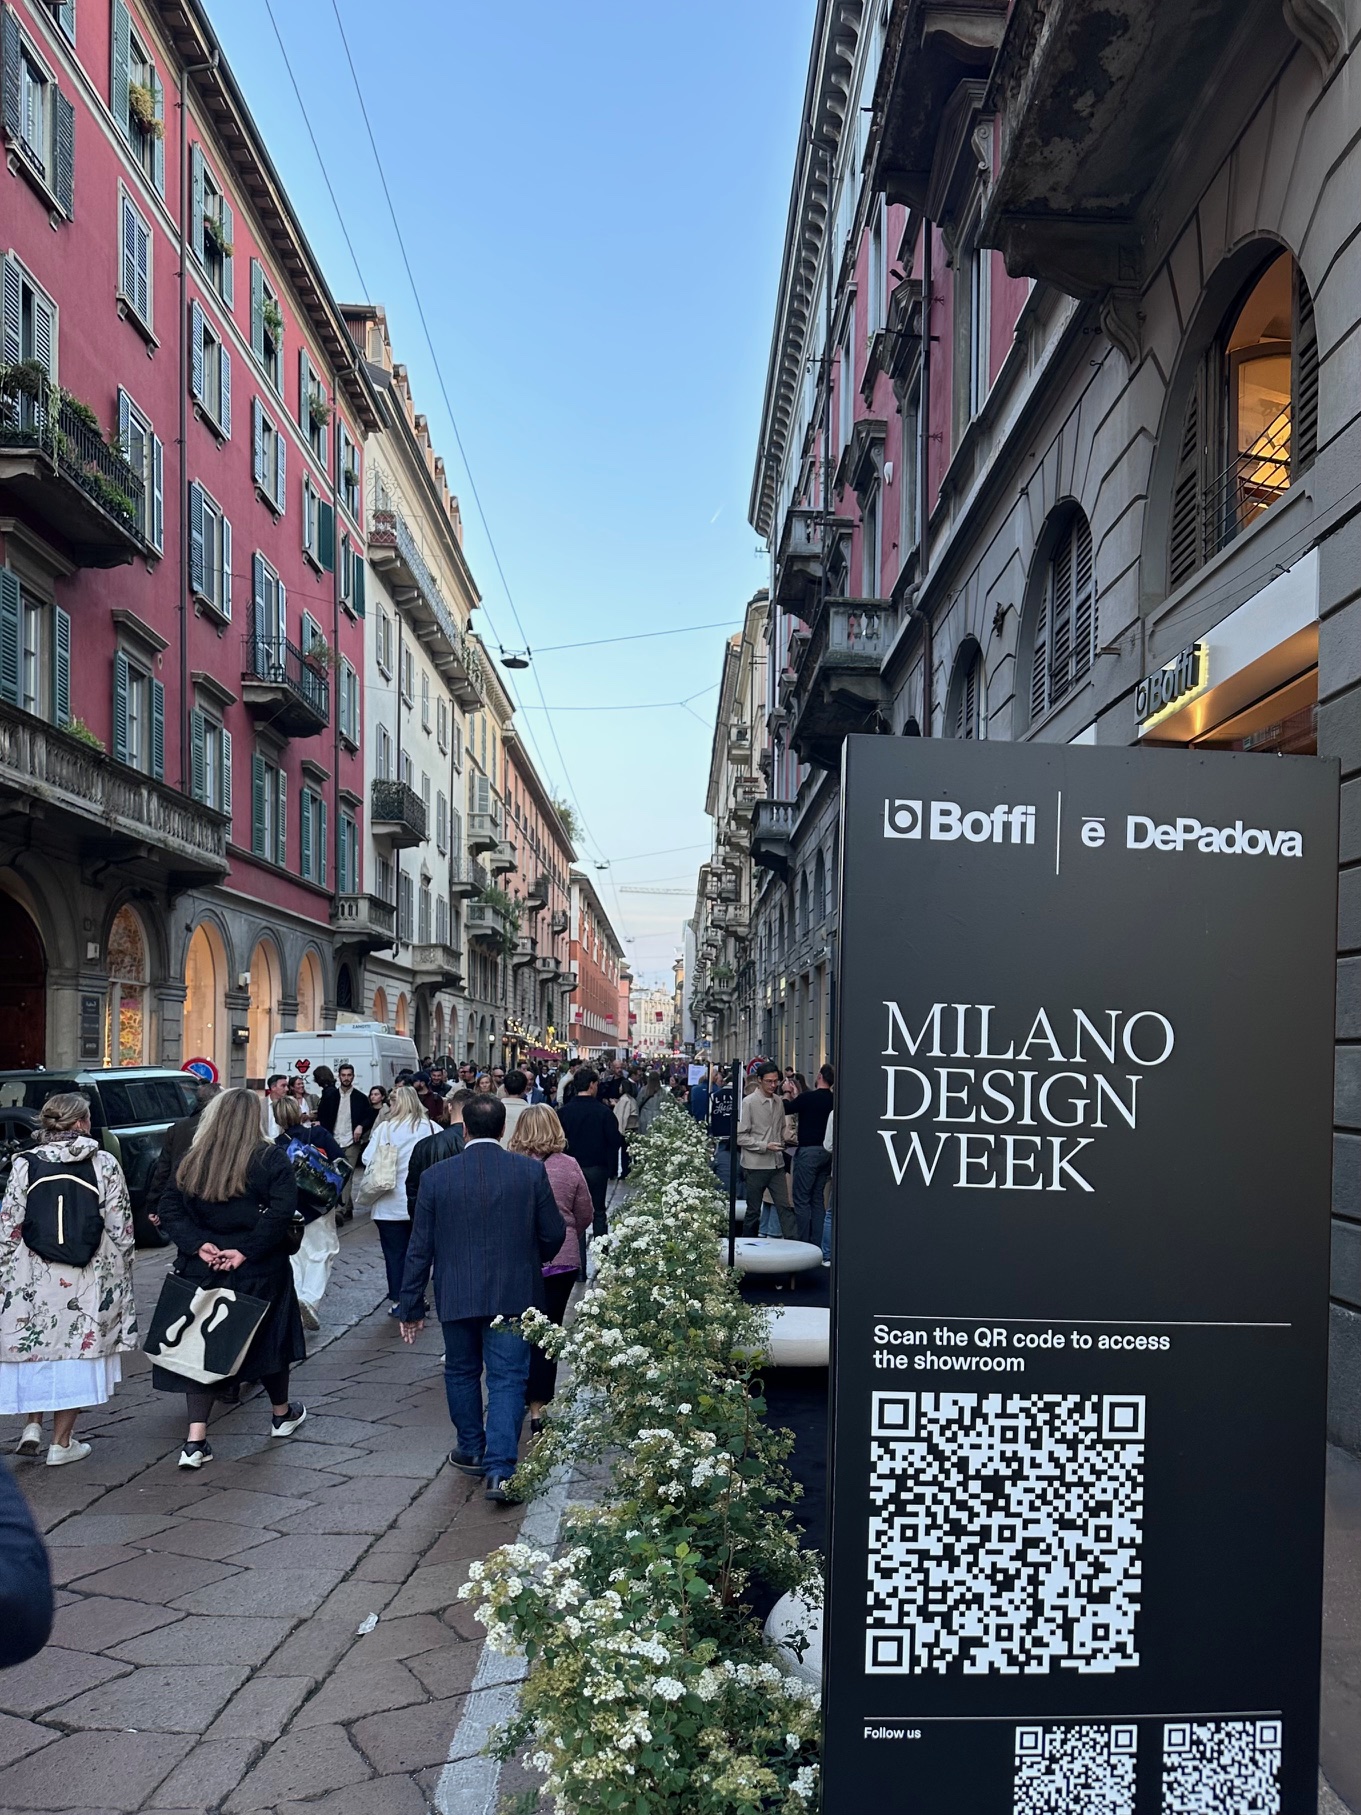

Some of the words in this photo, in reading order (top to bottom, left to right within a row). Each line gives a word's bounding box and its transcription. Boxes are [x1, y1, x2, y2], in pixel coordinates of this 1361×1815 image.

[929, 800, 1036, 845] Boffi
[1126, 814, 1303, 858] DePadova
[881, 1001, 1175, 1066] MILANO
[879, 1065, 1144, 1131] DESIGN
[876, 1130, 1097, 1193] WEEK
[873, 1324, 928, 1346] Scan
[932, 1327, 969, 1347] the
[973, 1327, 1008, 1349] QR
[1012, 1329, 1066, 1349] code
[1070, 1330, 1093, 1349] to
[1097, 1334, 1171, 1351] access
[872, 1350, 909, 1370] the
[913, 1350, 1025, 1372] showroom
[864, 1726, 904, 1739] Follow
[907, 1729, 922, 1739] us
